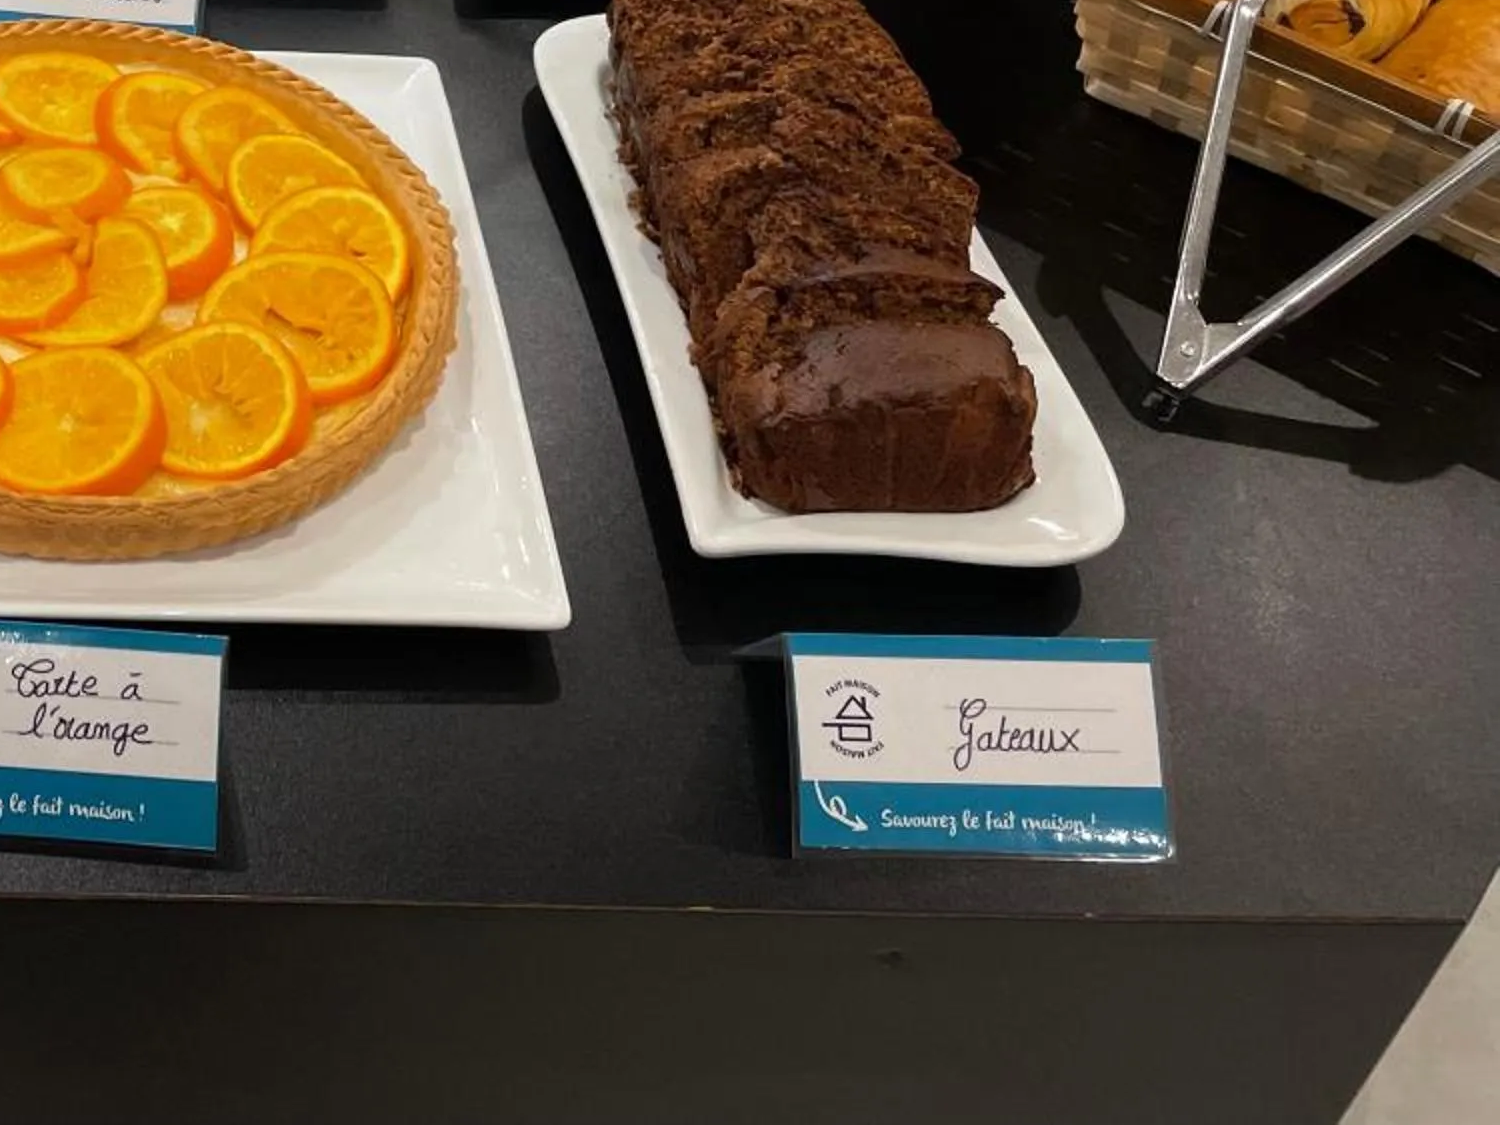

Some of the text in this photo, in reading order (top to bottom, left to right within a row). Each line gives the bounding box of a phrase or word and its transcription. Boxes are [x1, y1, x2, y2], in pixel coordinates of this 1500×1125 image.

[12, 658, 99, 698] Tarte
[19, 702, 153, 756] l'orange
[953, 697, 1081, 772] Gateaux
[9, 792, 27, 813] le
[32, 793, 63, 817] fait
[880, 807, 957, 837] Savourez
[961, 809, 980, 830] le
[985, 810, 1016, 832] fait
